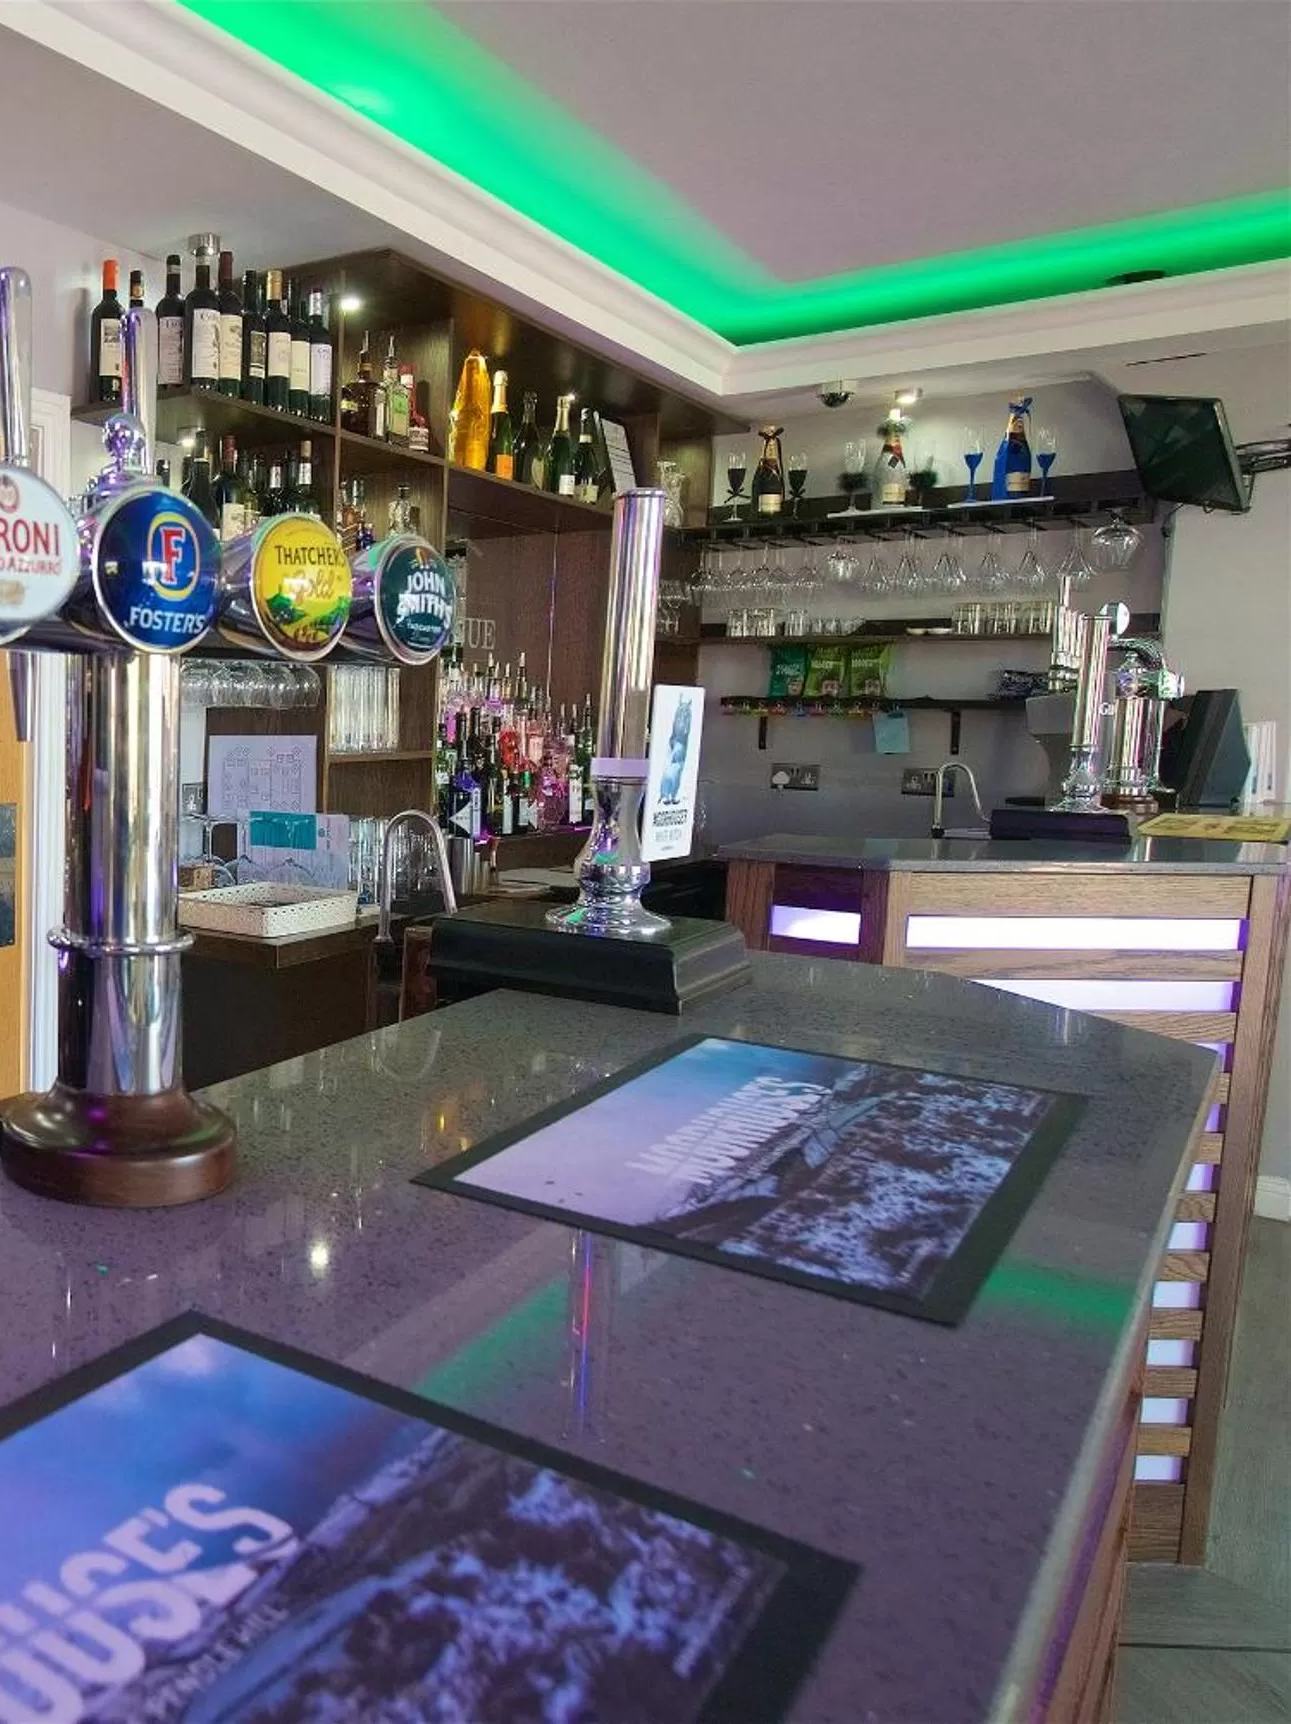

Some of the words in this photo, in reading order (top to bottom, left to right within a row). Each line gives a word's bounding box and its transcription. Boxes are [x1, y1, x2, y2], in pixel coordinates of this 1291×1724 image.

[7, 556, 62, 577] AZZURRO
[407, 570, 446, 598] JOHN
[130, 606, 207, 634] FOSTER'S
